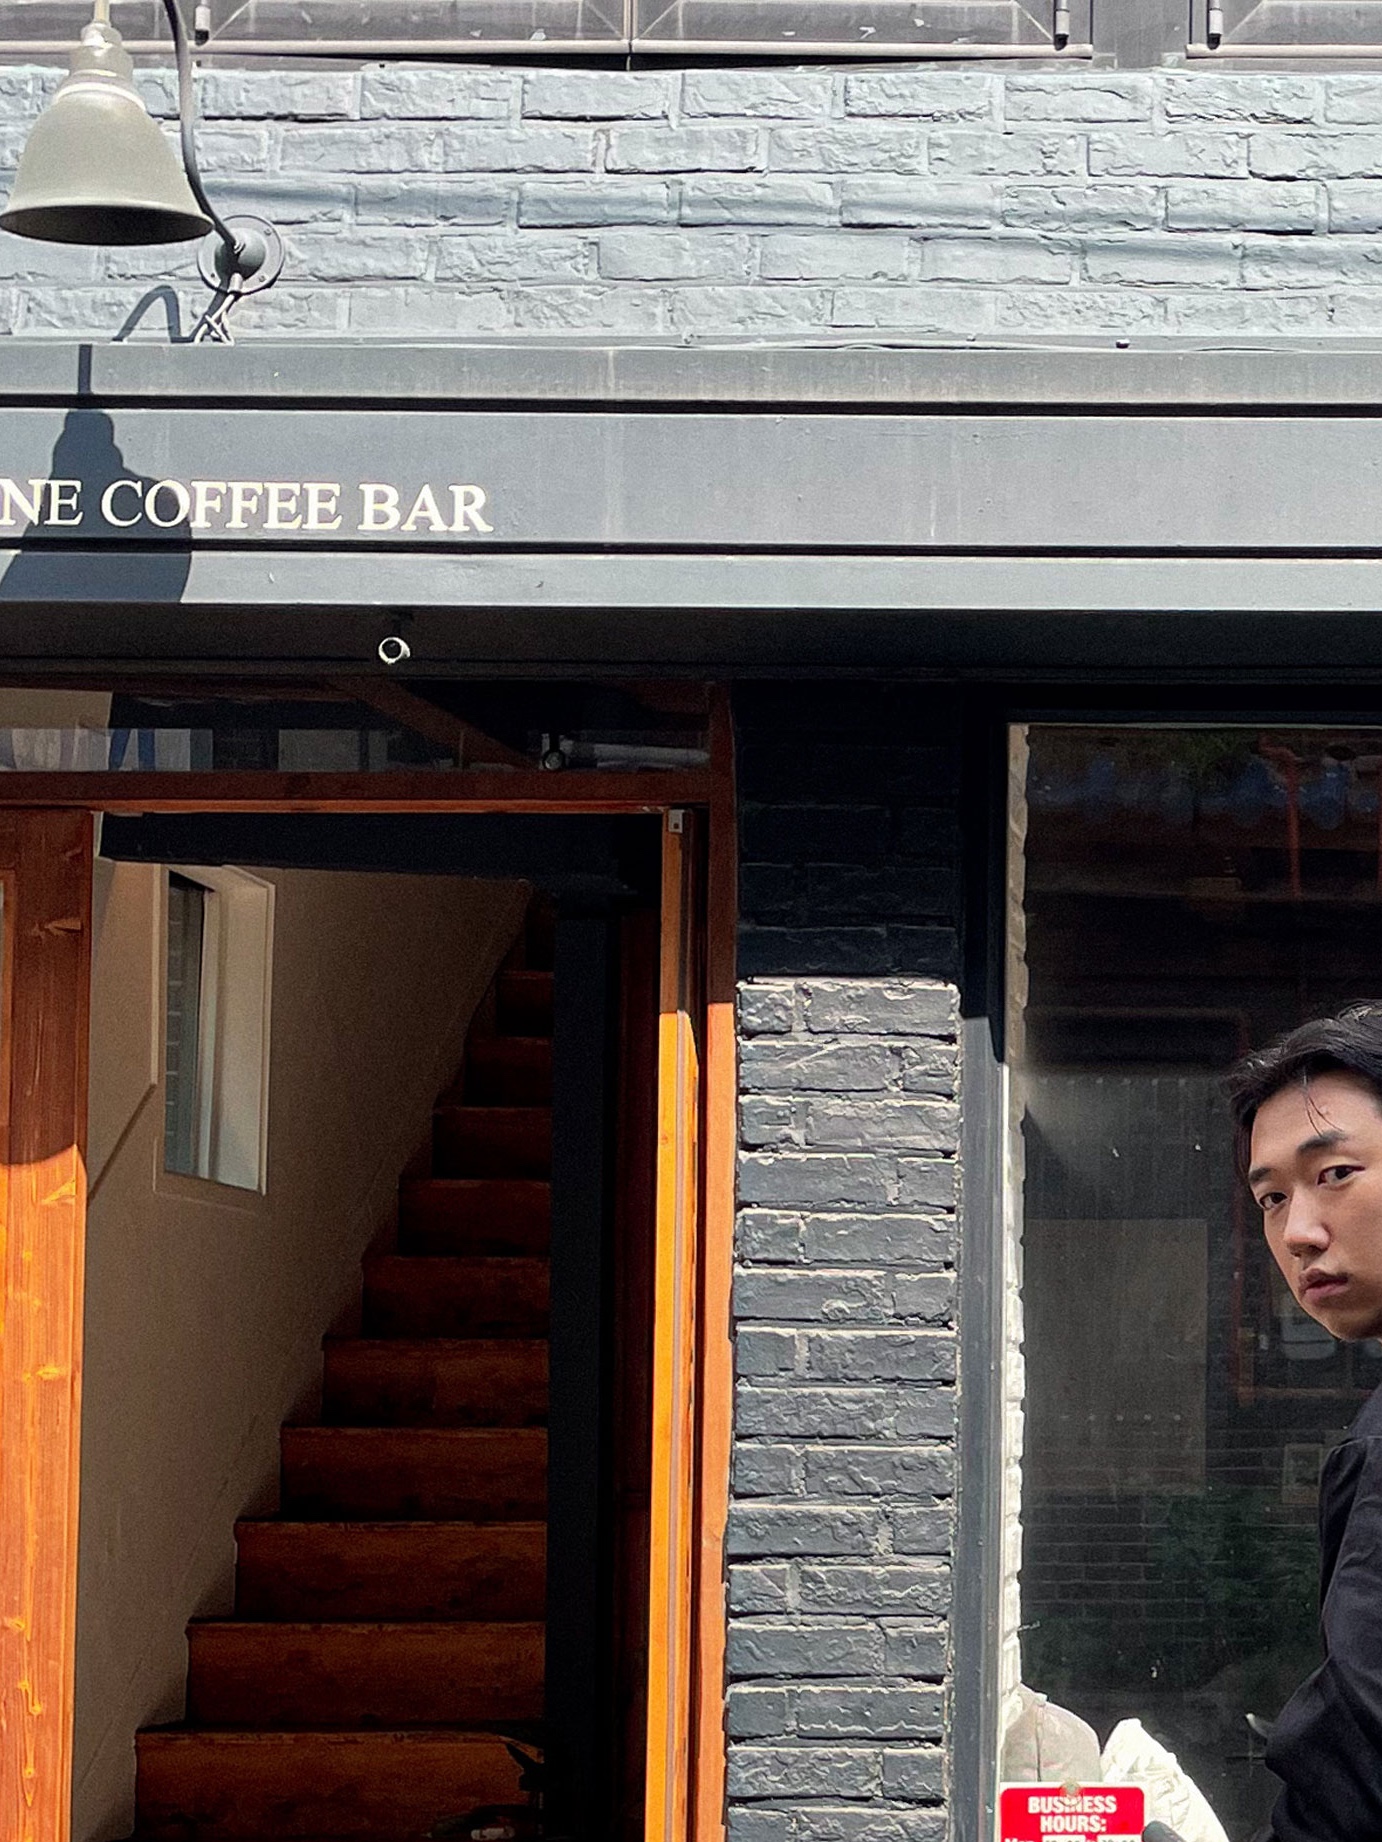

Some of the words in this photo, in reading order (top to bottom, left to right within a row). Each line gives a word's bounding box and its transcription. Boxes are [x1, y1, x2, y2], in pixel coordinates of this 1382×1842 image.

[0, 479, 83, 526] NE
[101, 480, 342, 530] COFFEE
[358, 484, 494, 532] BAR
[1028, 1796, 1117, 1814] BUSINESS
[1040, 1815, 1107, 1833] HOURS:
